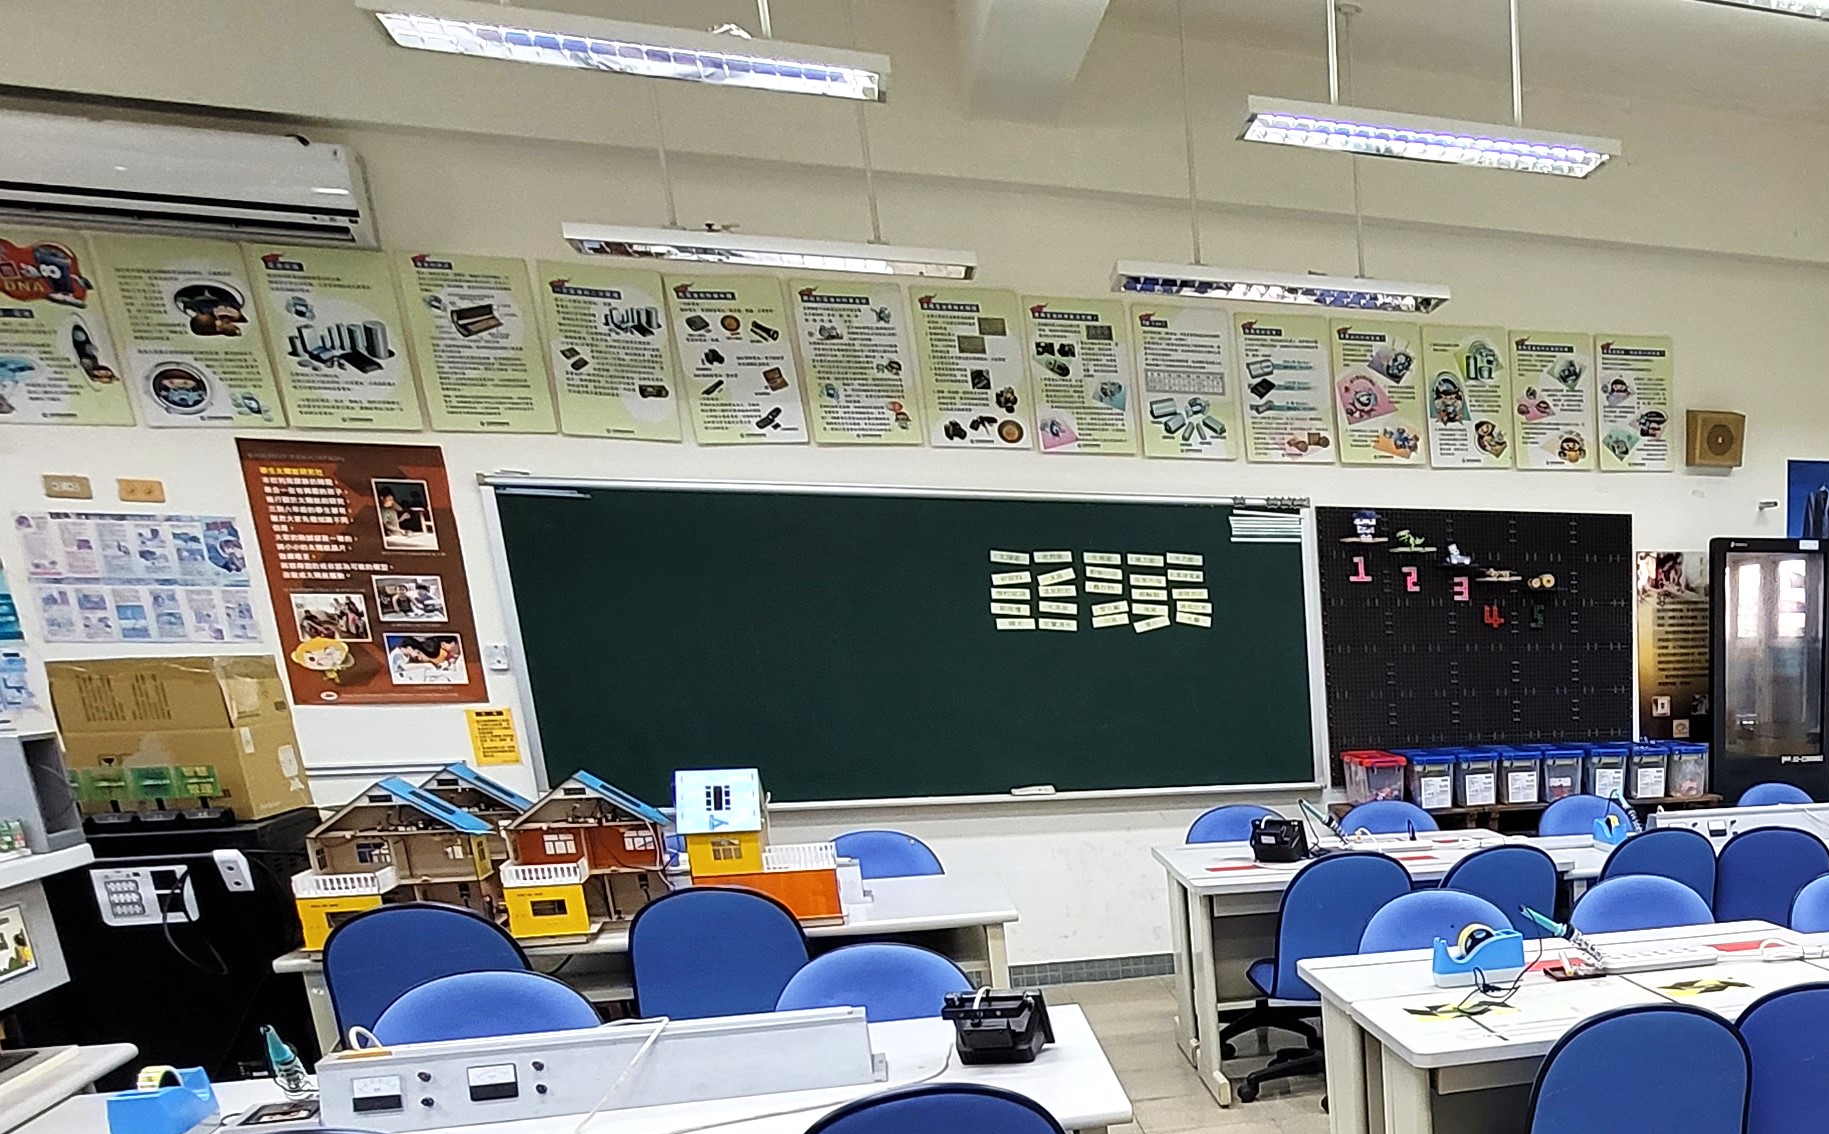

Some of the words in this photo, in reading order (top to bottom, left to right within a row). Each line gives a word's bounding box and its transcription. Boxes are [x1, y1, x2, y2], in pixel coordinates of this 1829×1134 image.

[4, 280, 44, 293] DNA
[1349, 556, 1373, 583] 1
[1401, 566, 1421, 592] 2
[1453, 576, 1470, 602] 3
[1483, 604, 1505, 629] 4
[1530, 604, 1546, 629] 5
